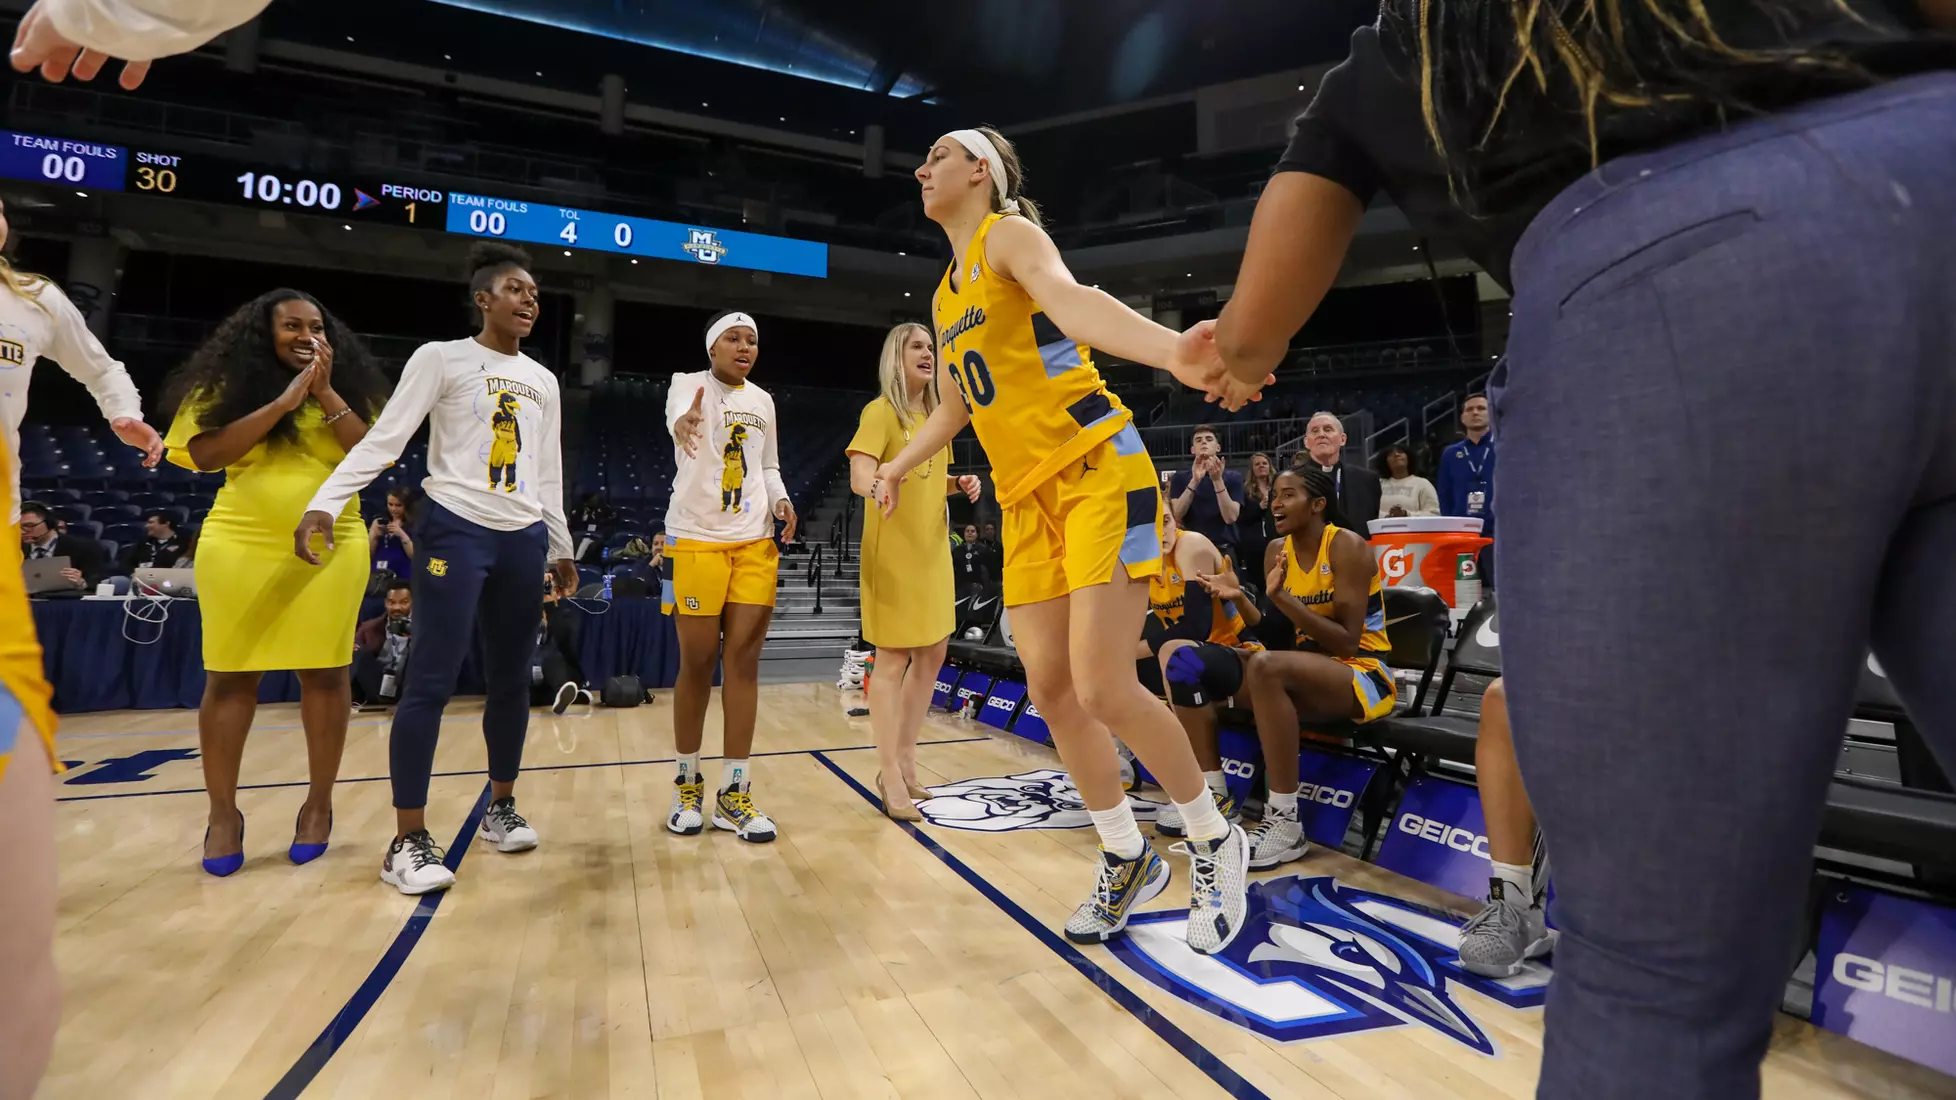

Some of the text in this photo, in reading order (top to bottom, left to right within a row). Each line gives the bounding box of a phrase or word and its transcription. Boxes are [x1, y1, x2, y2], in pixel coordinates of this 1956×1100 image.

[12, 133, 117, 159] TEAM FOULS
[42, 154, 86, 182] 00
[136, 152, 181, 167] SHOT
[135, 167, 177, 193] 30
[237, 172, 342, 210] 10:00
[382, 184, 442, 203] PERIOD
[449, 193, 528, 214] TEAM FOULS
[405, 203, 416, 224] 1
[469, 210, 506, 236] 00
[559, 208, 581, 221] TOL
[560, 222, 578, 244] 4
[614, 223, 633, 248] 0
[1382, 548, 1406, 578] G
[934, 681, 952, 694] EICO
[987, 696, 1015, 711] GEICO
[1220, 757, 1255, 779] ICO
[1833, 952, 1956, 1014] GEI
